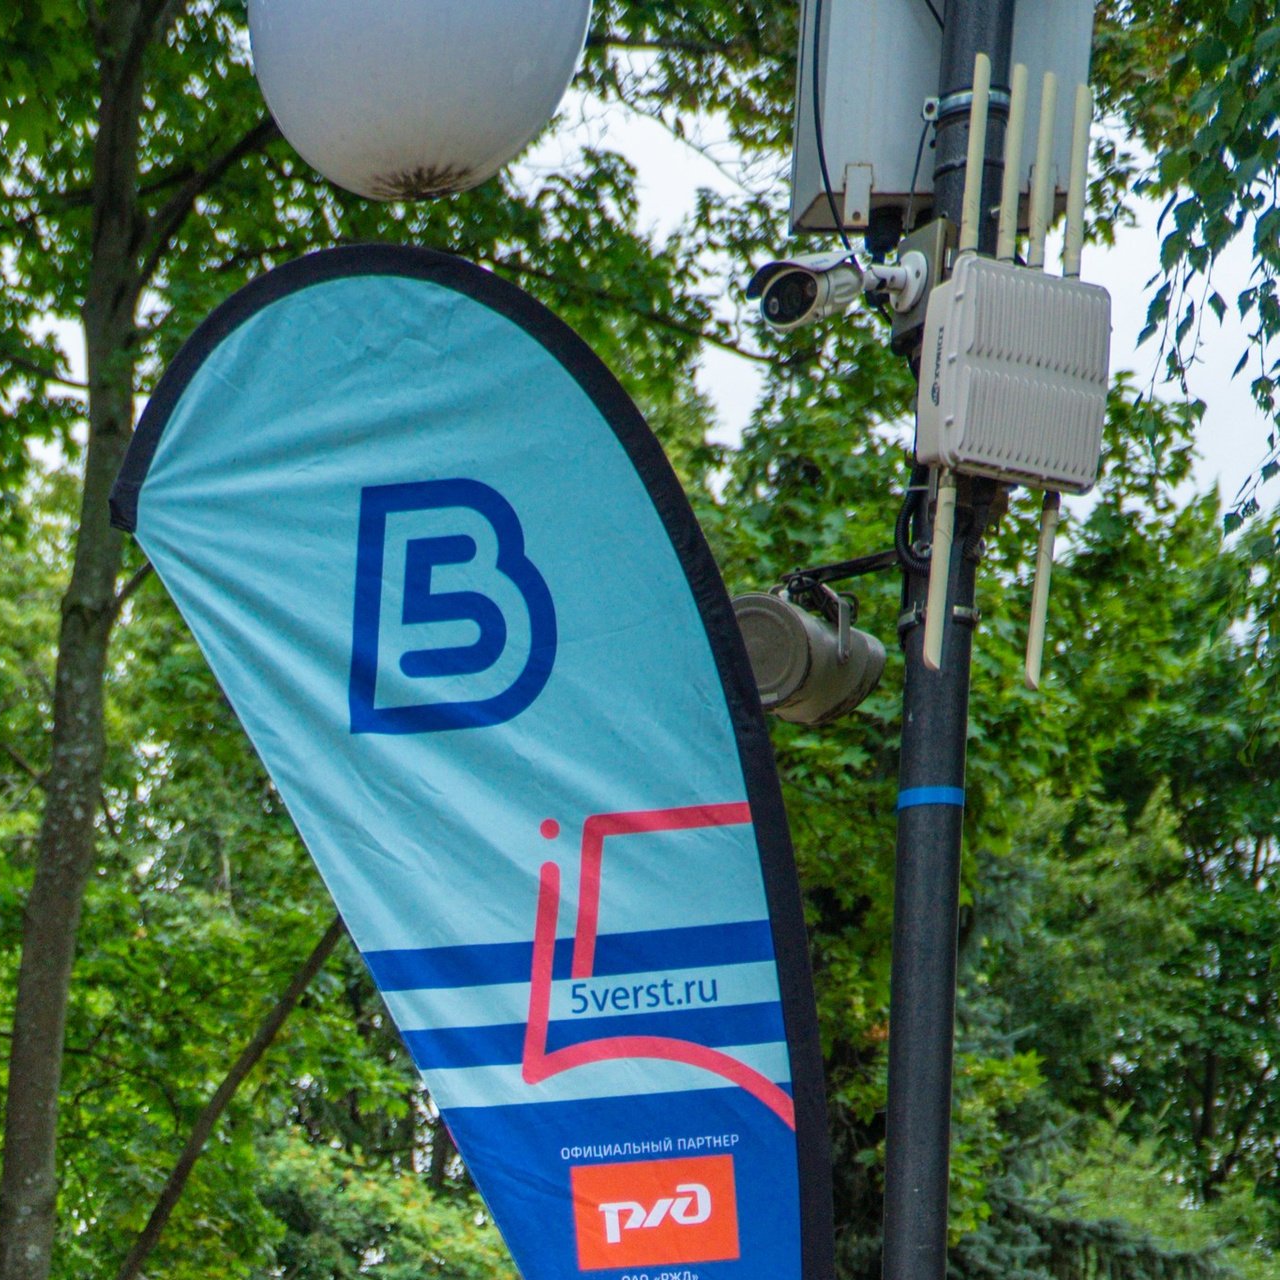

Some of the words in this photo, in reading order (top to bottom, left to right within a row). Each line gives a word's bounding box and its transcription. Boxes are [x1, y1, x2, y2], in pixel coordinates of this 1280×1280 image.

[571, 978, 718, 1014] 5verst.ru
[560, 1137, 673, 1160] ОФИЦИАЛЬНЫЙ
[677, 1133, 740, 1151] ПАРТНЕР
